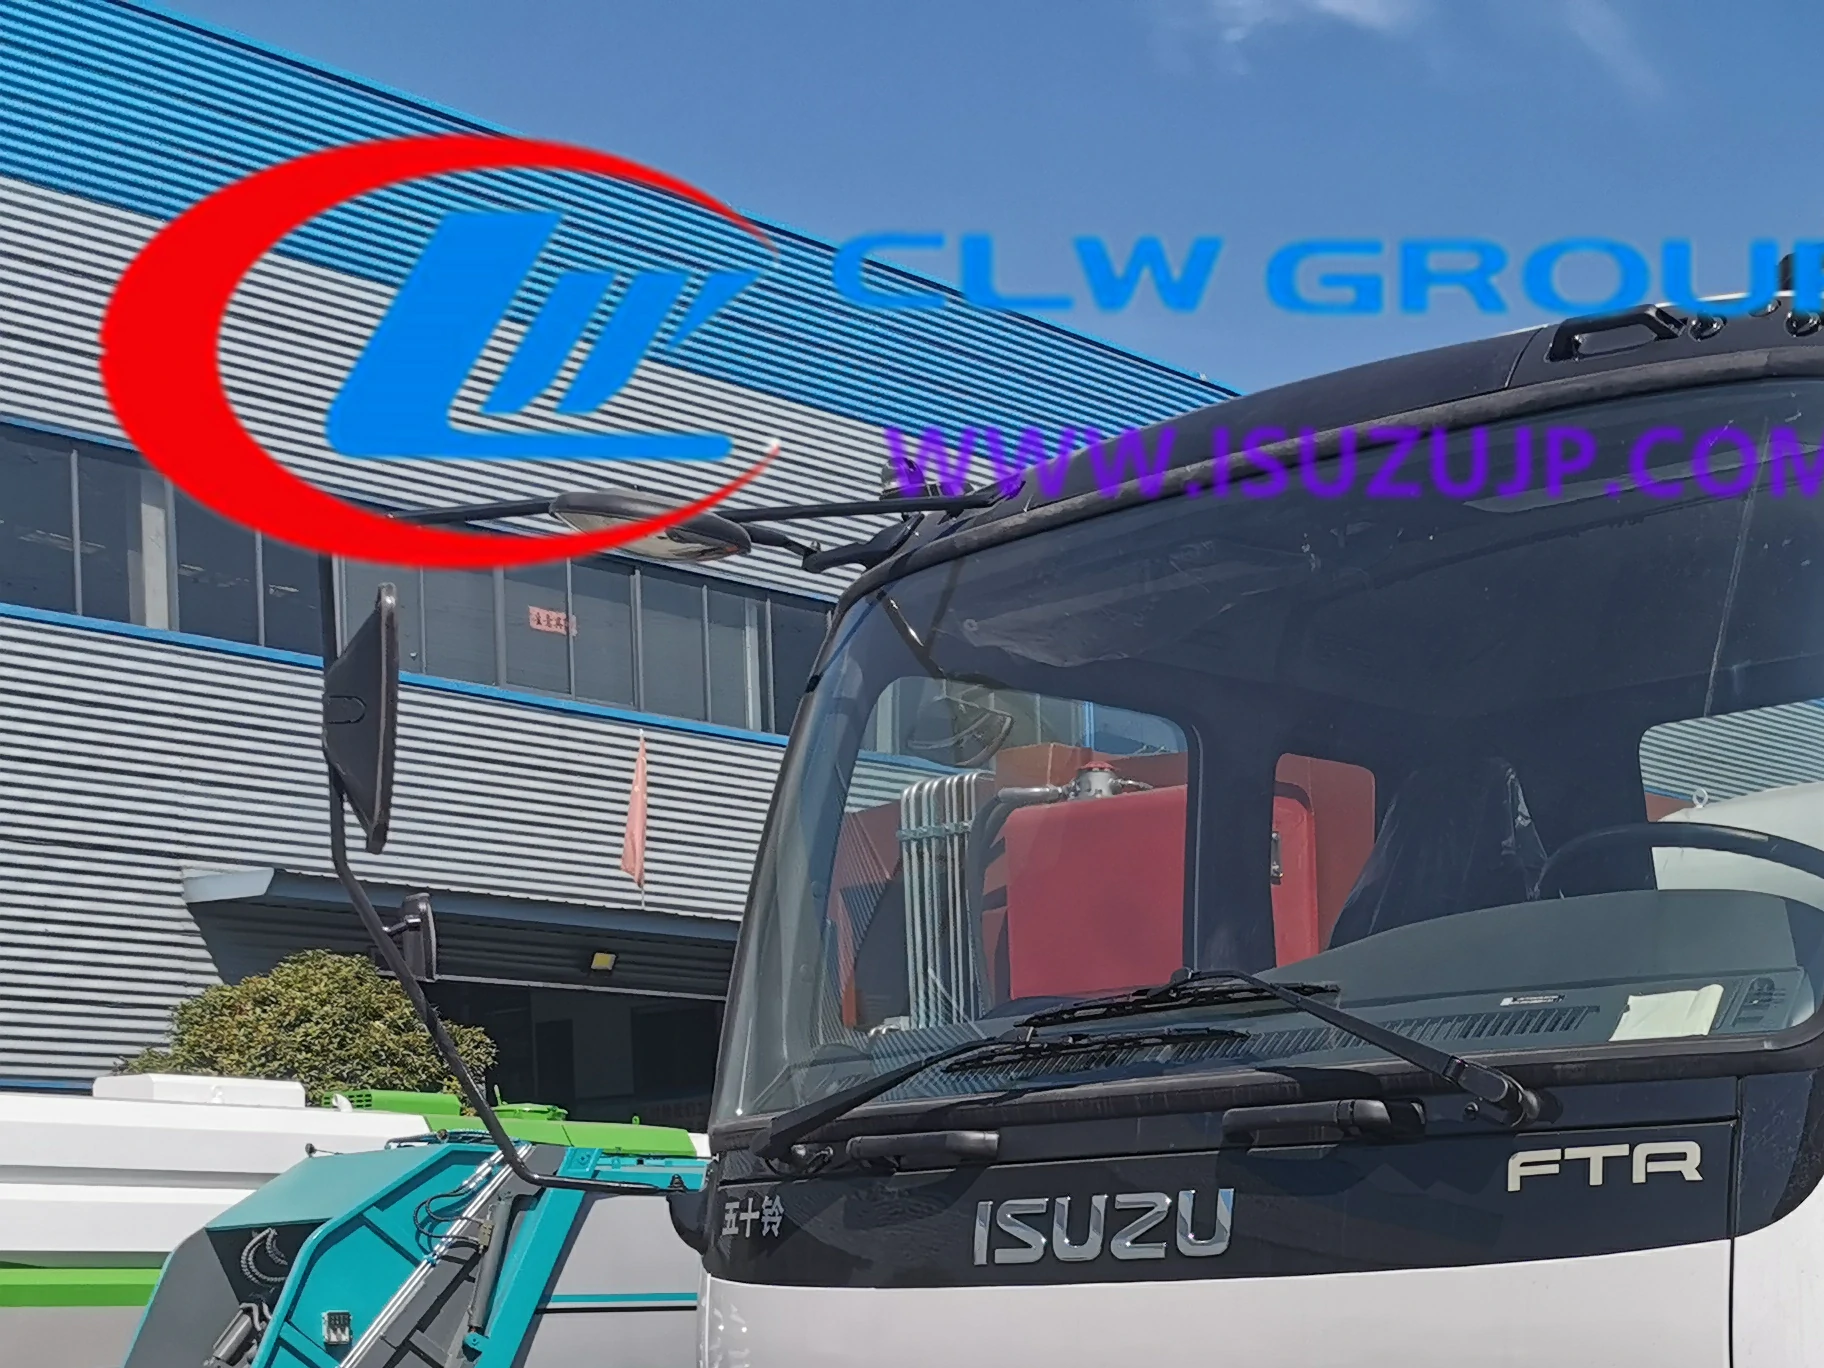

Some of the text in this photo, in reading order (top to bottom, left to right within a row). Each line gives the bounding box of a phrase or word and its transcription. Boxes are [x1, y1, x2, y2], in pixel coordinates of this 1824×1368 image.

[1507, 1140, 1704, 1193] FTR
[721, 1194, 785, 1238] 五十铃
[973, 1187, 1236, 1267] ISUZU
